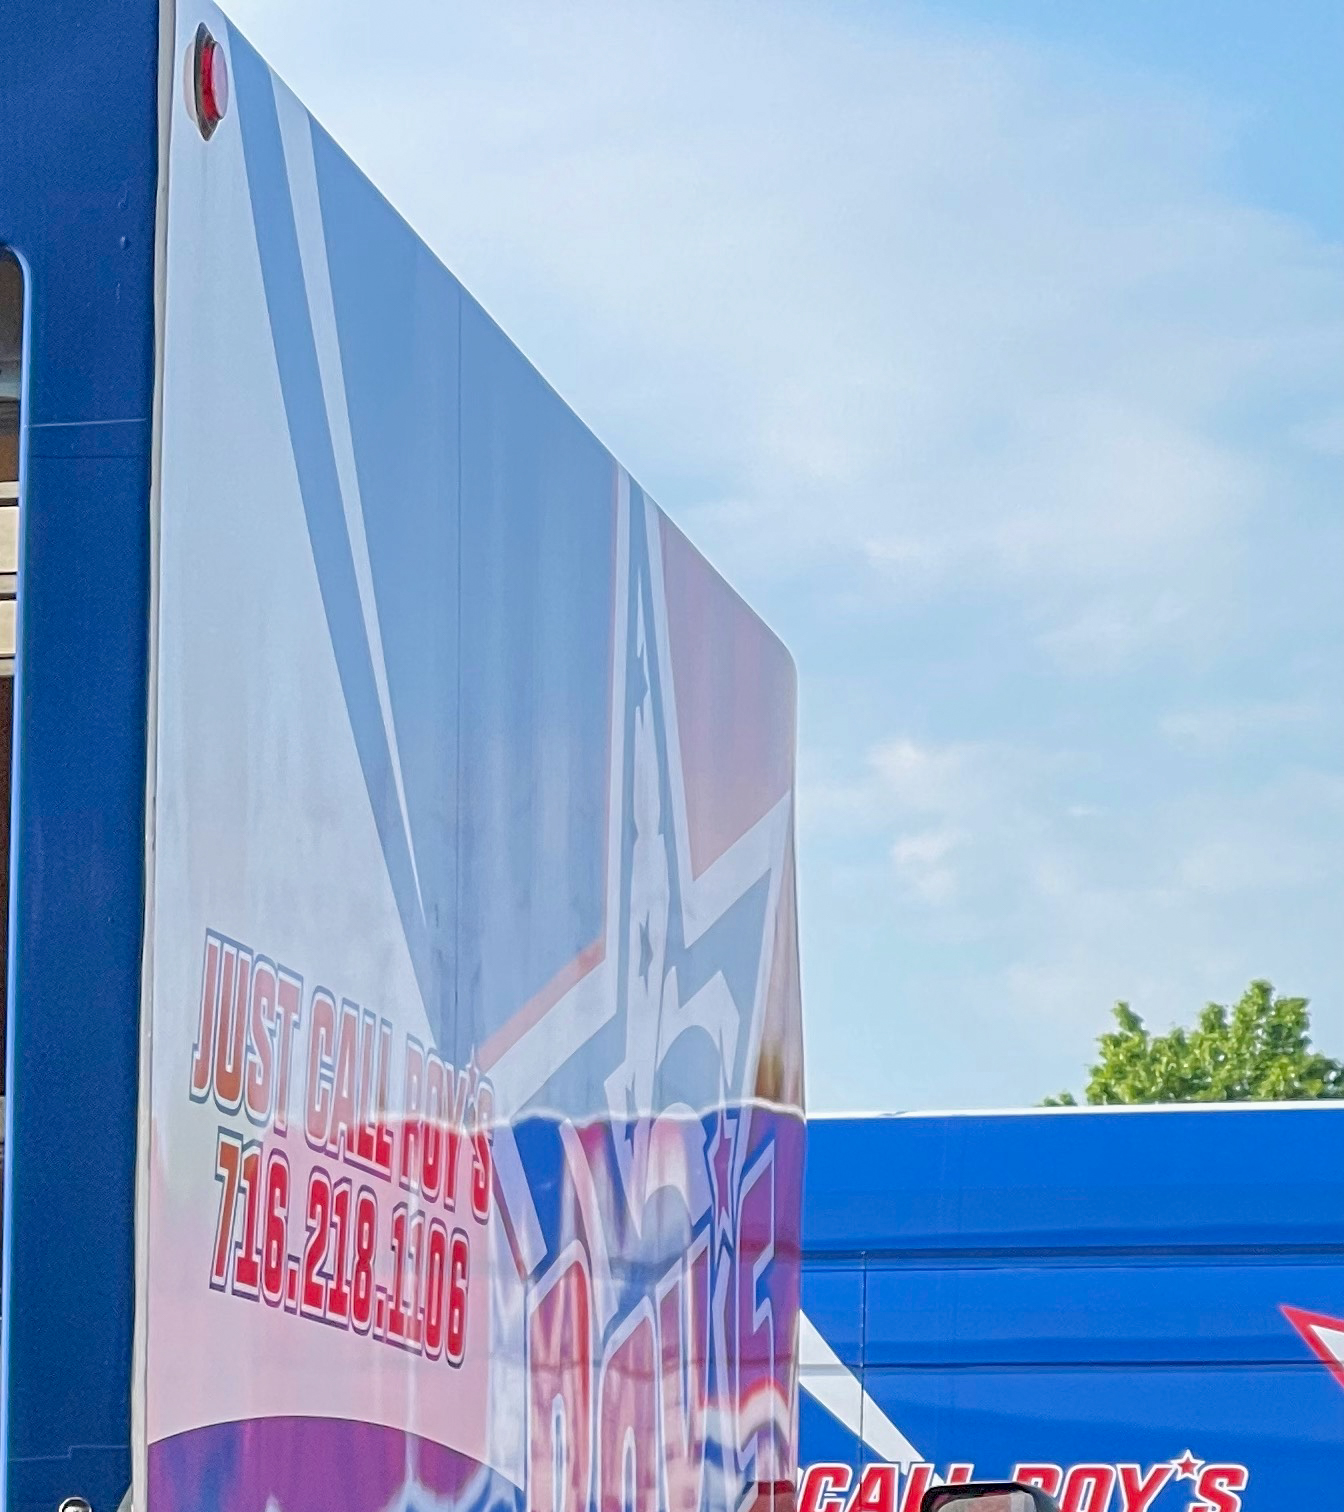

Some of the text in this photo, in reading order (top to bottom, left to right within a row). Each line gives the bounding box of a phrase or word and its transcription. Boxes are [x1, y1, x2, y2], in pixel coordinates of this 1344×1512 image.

[189, 928, 303, 1138] JUST
[305, 986, 393, 1182] CALL
[209, 1127, 470, 1370] 716.218.1106
